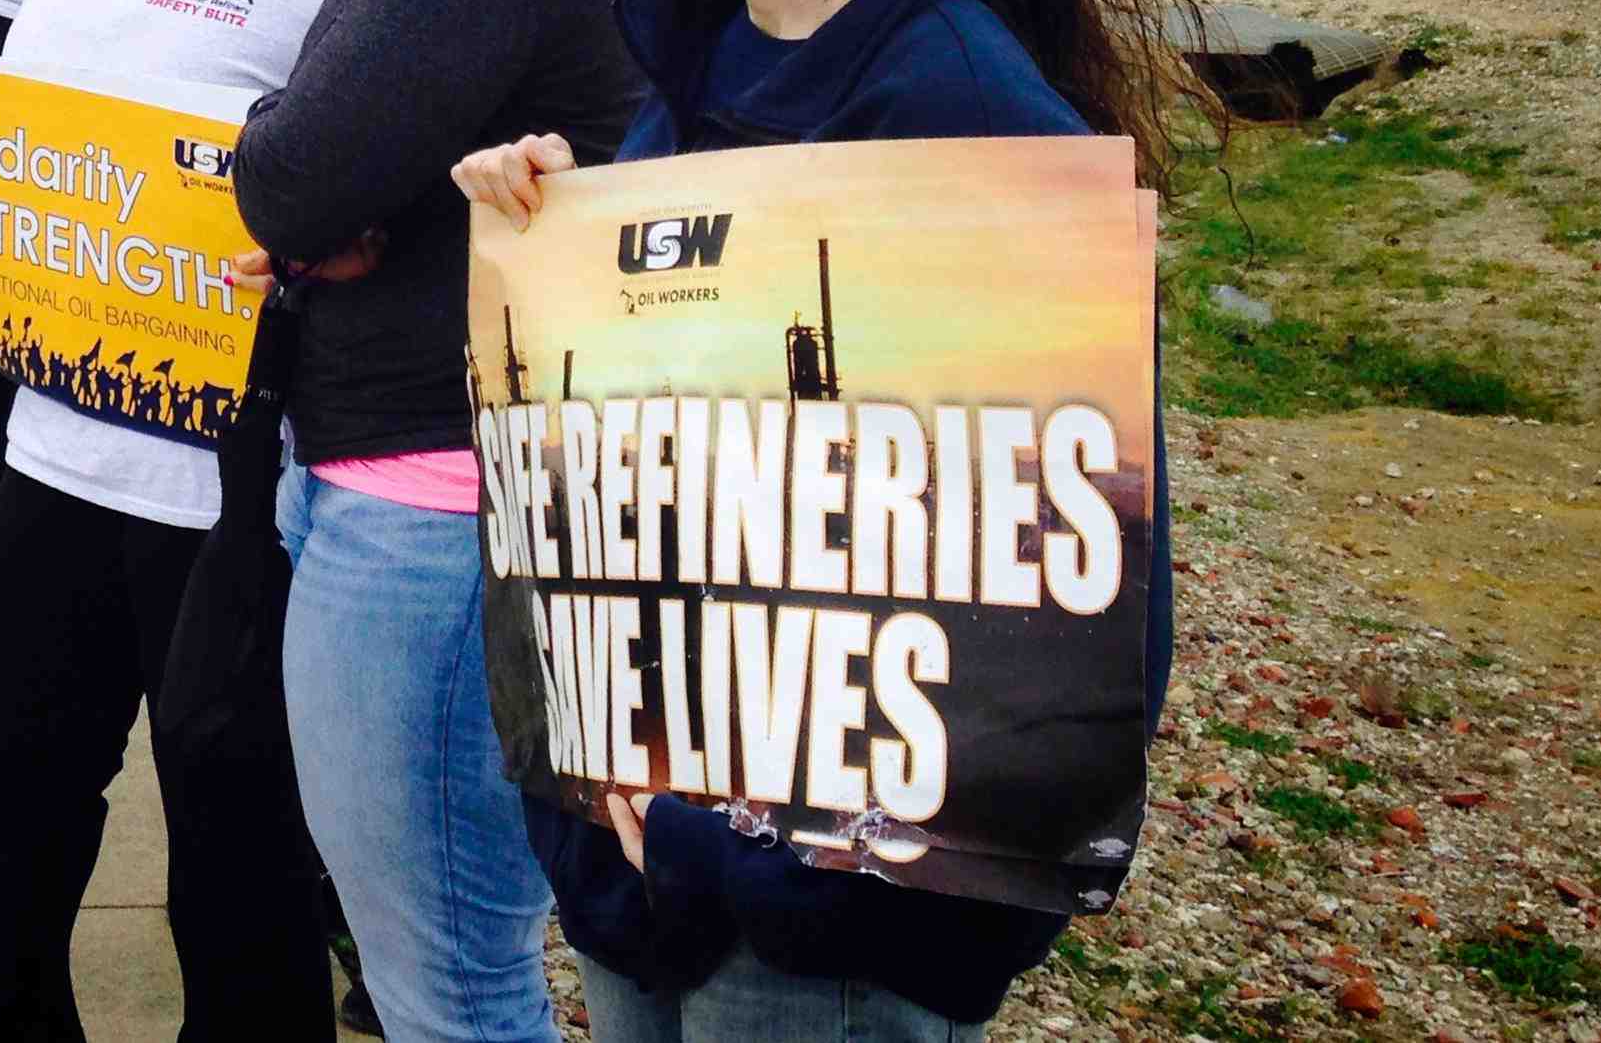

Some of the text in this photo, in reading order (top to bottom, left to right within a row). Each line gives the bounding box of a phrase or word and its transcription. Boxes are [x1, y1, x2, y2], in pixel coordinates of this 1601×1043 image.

[204, 7, 247, 28] BLITZ
[618, 213, 733, 274] USW
[68, 295, 99, 322] OIL
[105, 306, 236, 357] BARGAINING
[638, 287, 720, 307] OIL WORKERS
[560, 396, 1123, 615] REFINERIES
[532, 589, 951, 823] SAVE LIVES
